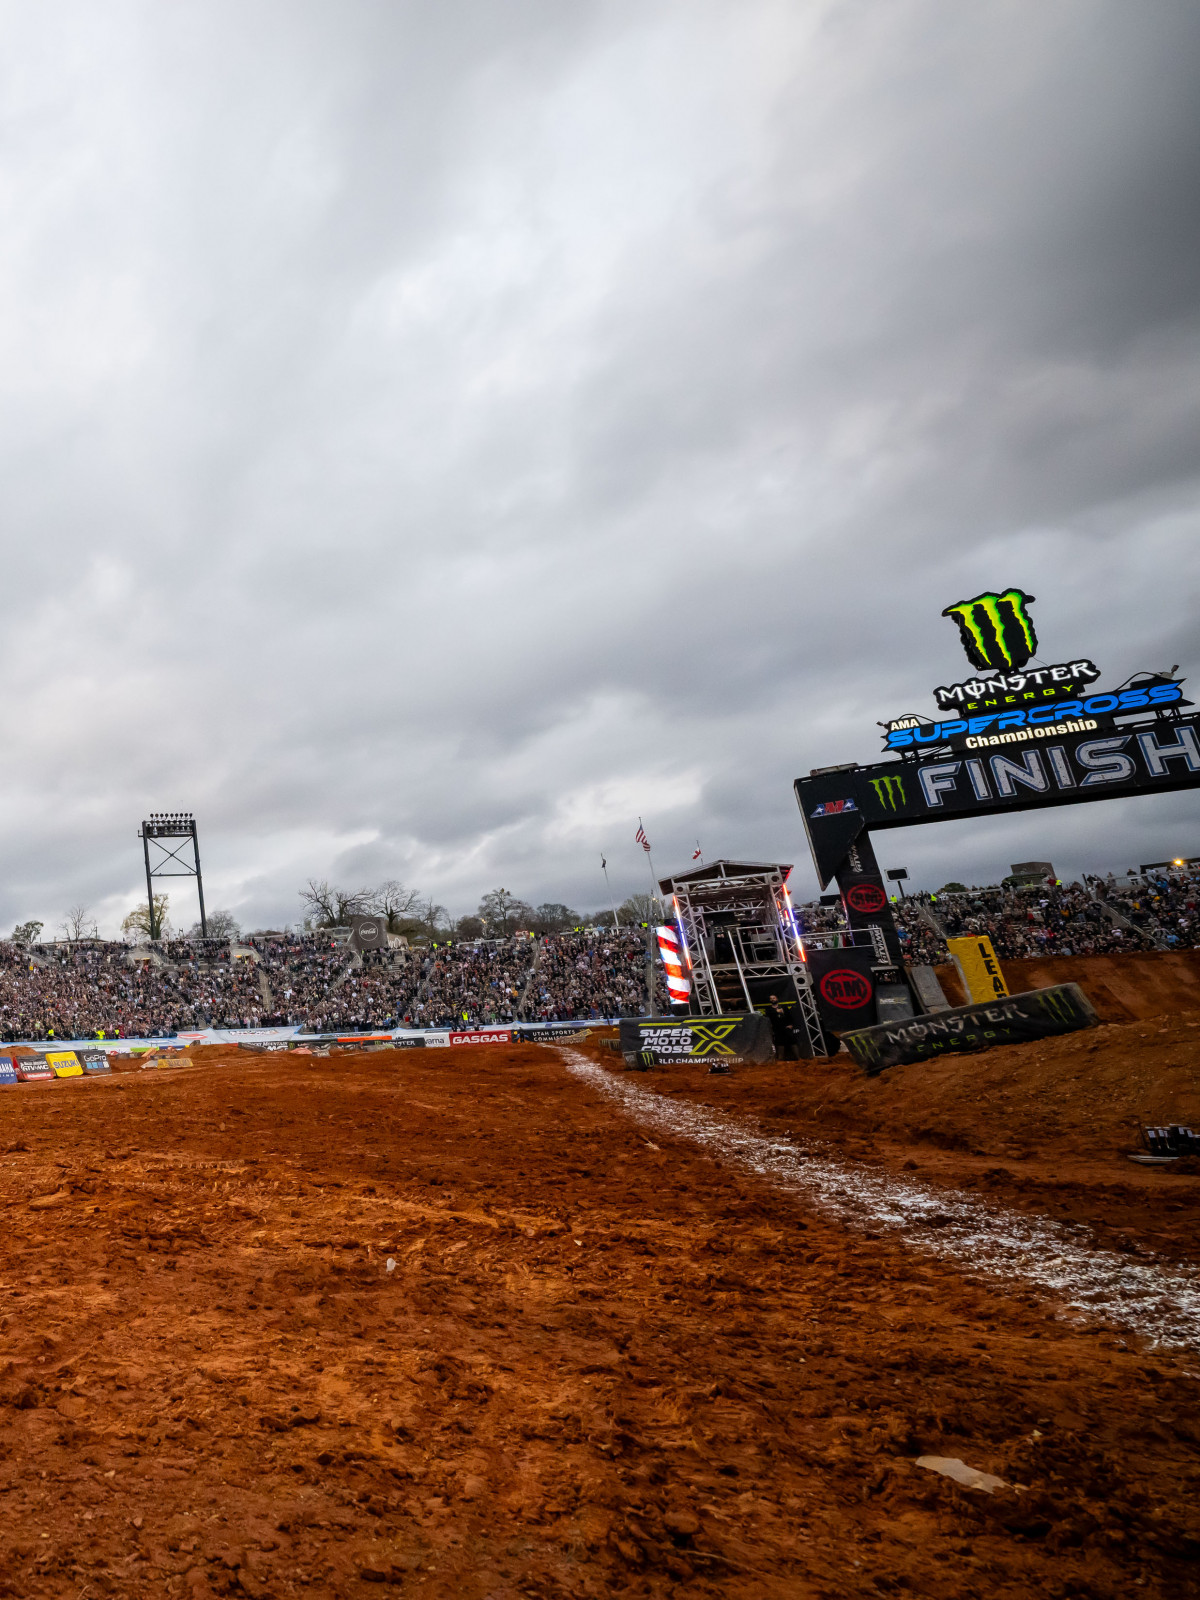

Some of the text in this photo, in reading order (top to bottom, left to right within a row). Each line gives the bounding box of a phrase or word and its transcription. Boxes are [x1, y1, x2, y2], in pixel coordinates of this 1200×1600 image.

[938, 661, 1098, 704] MONSTER
[966, 684, 1074, 710] ENERGY
[886, 682, 1183, 748] SUPERCROSS
[890, 718, 920, 732] AMA
[965, 717, 1098, 750] Championship
[917, 725, 1200, 808] FINISH
[810, 798, 859, 818] AMA
[830, 981, 862, 998] RM
[639, 1028, 693, 1038] SUPER
[884, 1003, 1030, 1045] MONSTER
[452, 1033, 509, 1045] GASGAS
[643, 1036, 692, 1046] MOTO
[52, 1059, 80, 1069] SUZUKI
[83, 1054, 107, 1062] GoPro
